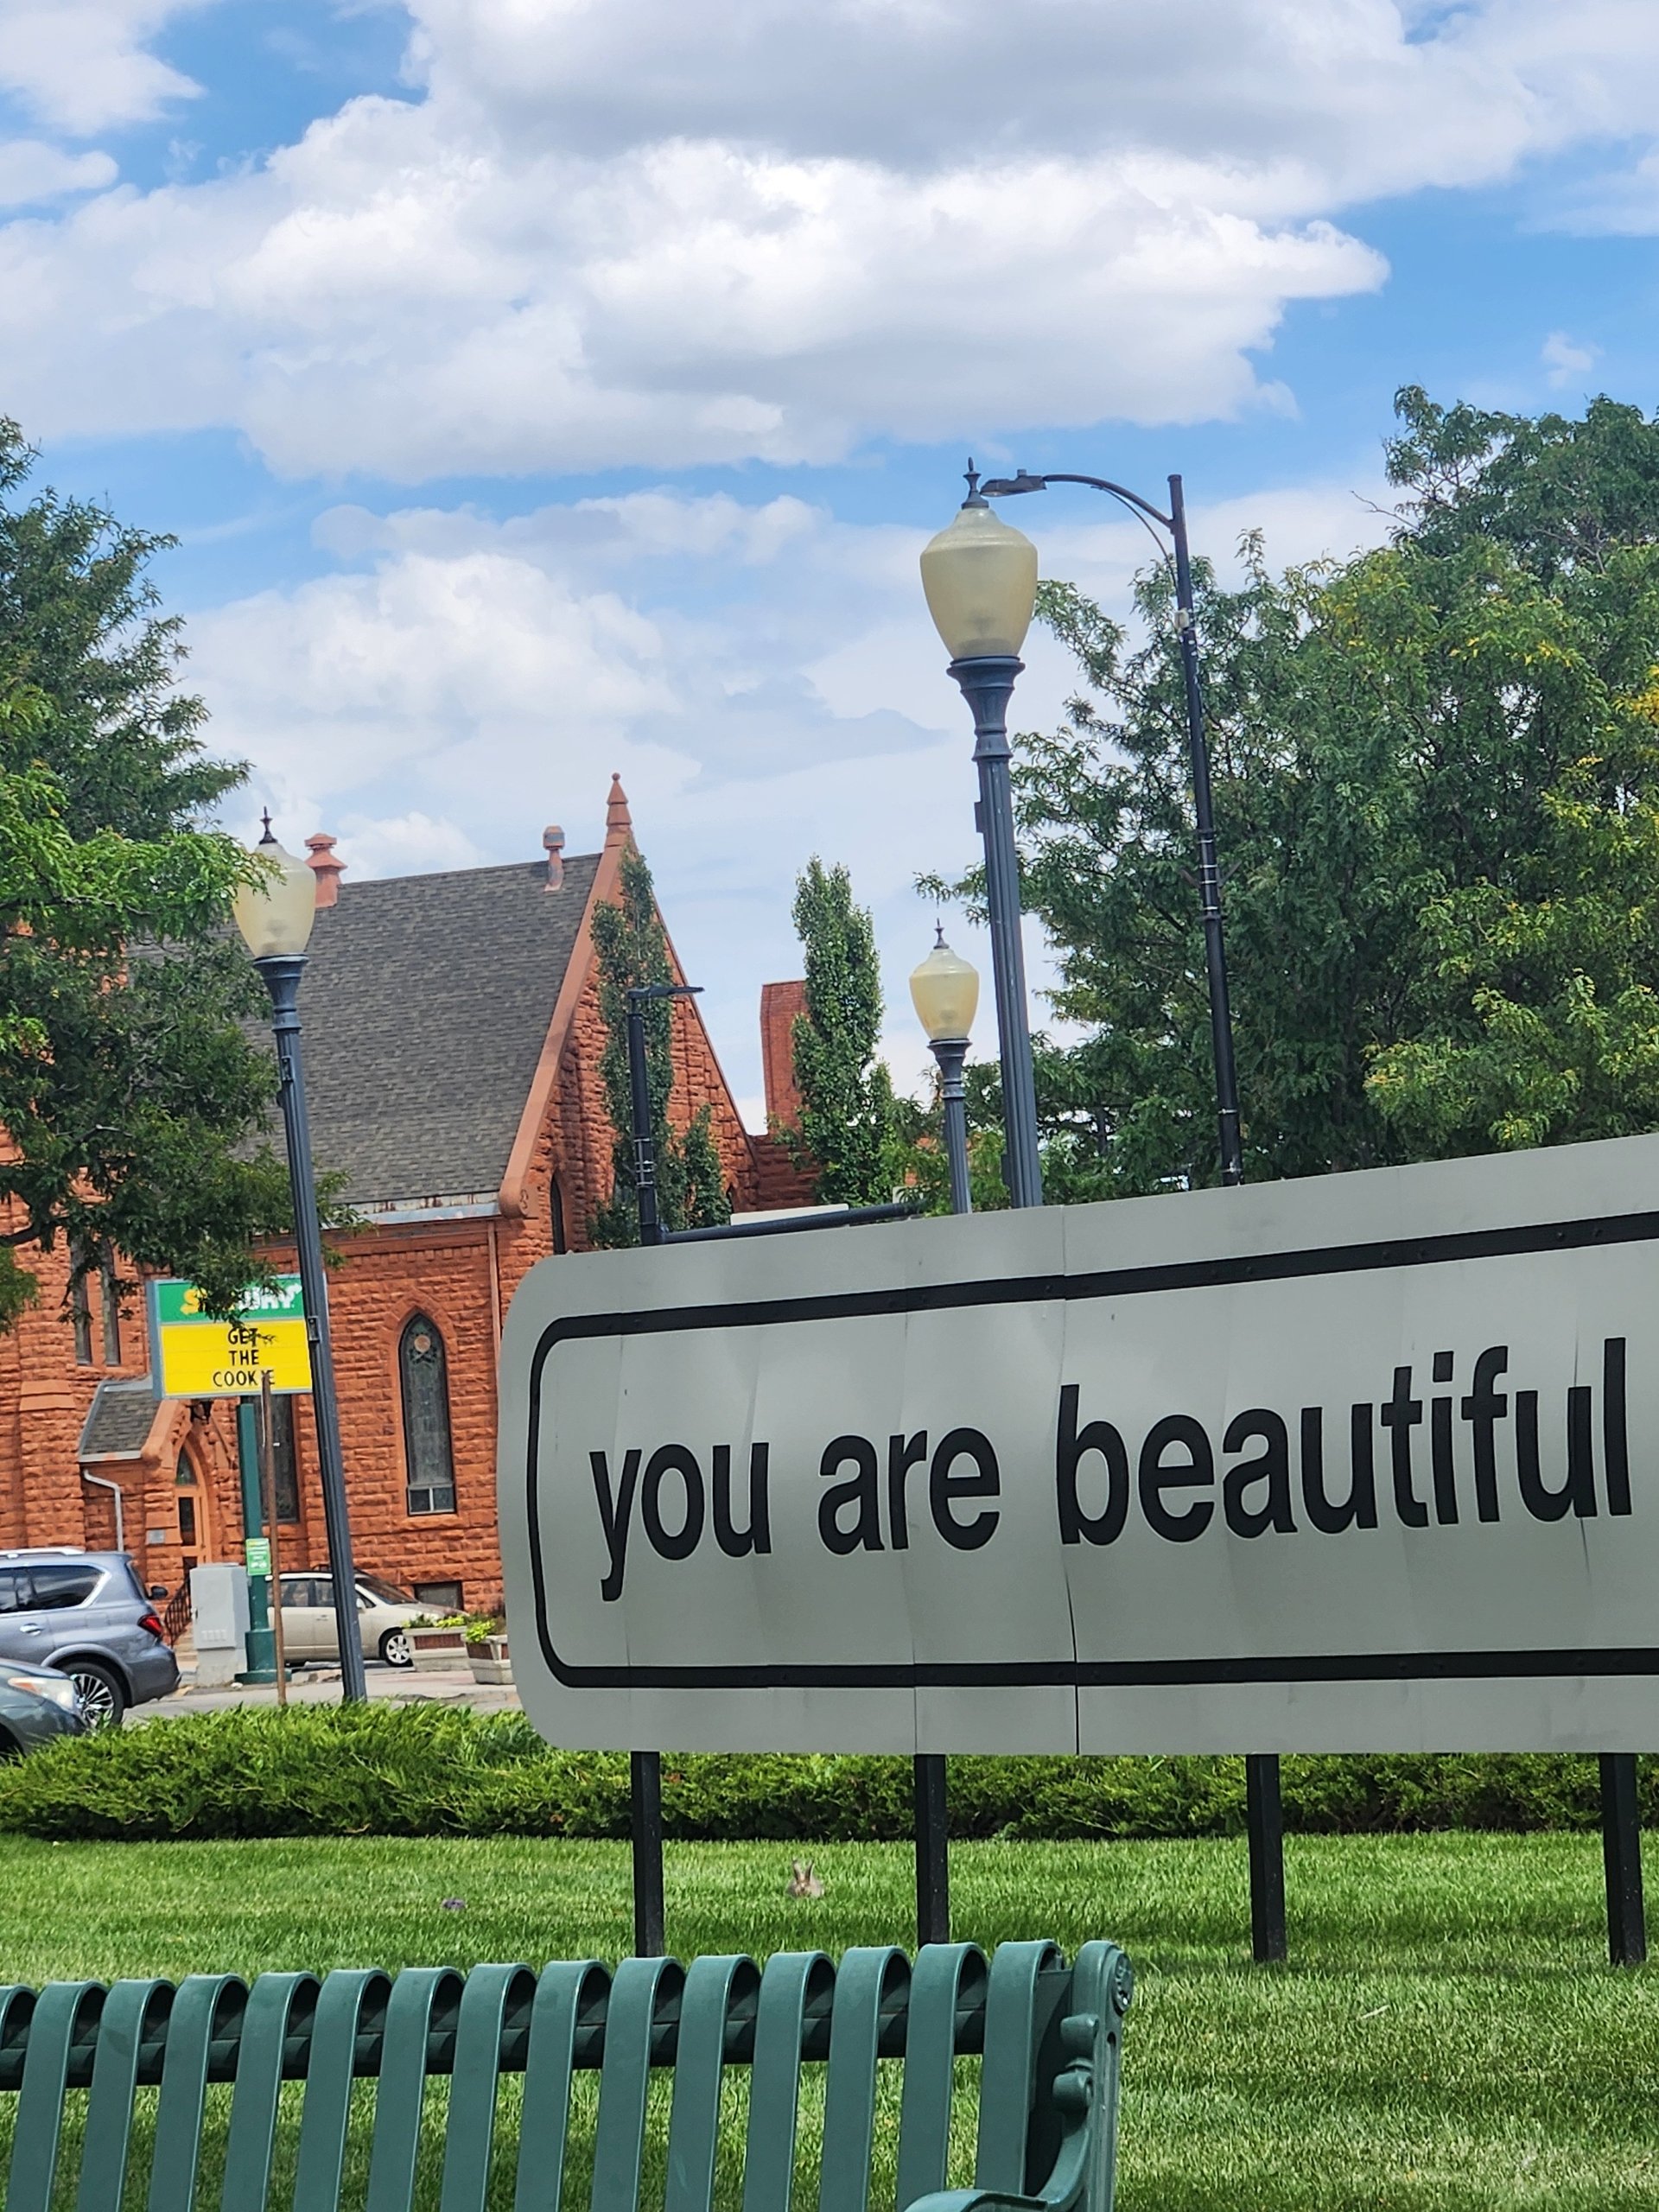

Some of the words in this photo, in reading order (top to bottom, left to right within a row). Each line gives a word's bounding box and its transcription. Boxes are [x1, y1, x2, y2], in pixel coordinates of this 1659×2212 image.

[180, 1283, 302, 1315] SWAY
[228, 1327, 258, 1346] GET
[228, 1350, 259, 1366] THE
[213, 1369, 276, 1387] COOKE
[589, 1441, 772, 1602] you
[817, 1427, 1000, 1555] are
[1056, 1337, 1633, 1547] beautiful
